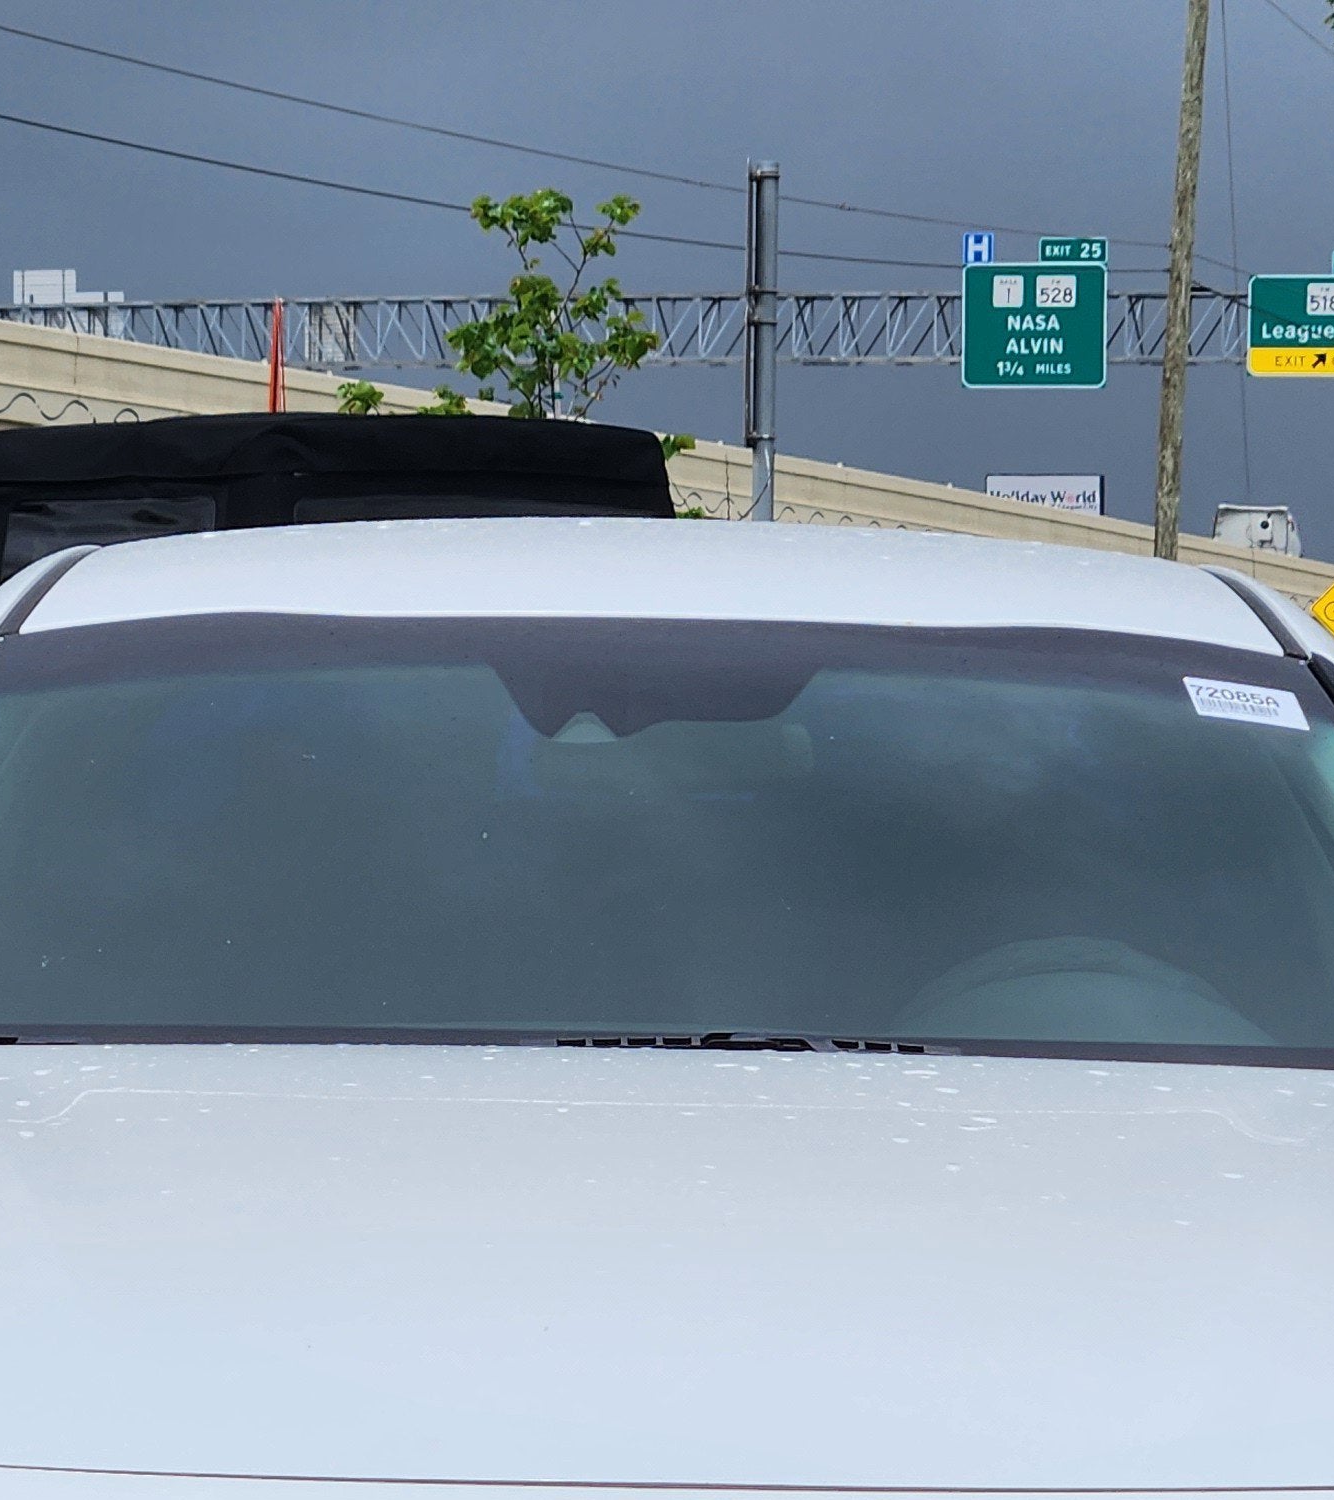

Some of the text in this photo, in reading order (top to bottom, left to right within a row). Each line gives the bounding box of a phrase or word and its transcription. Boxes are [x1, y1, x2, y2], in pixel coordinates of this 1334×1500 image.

[1045, 243, 1102, 258] EXIT 25
[1040, 287, 1073, 303] 528
[1007, 313, 1060, 331] NASA
[1005, 337, 1064, 355] ALVIN
[1035, 363, 1072, 374] MILES
[1275, 356, 1306, 367] EXIT
[1189, 684, 1280, 708] 72085A
